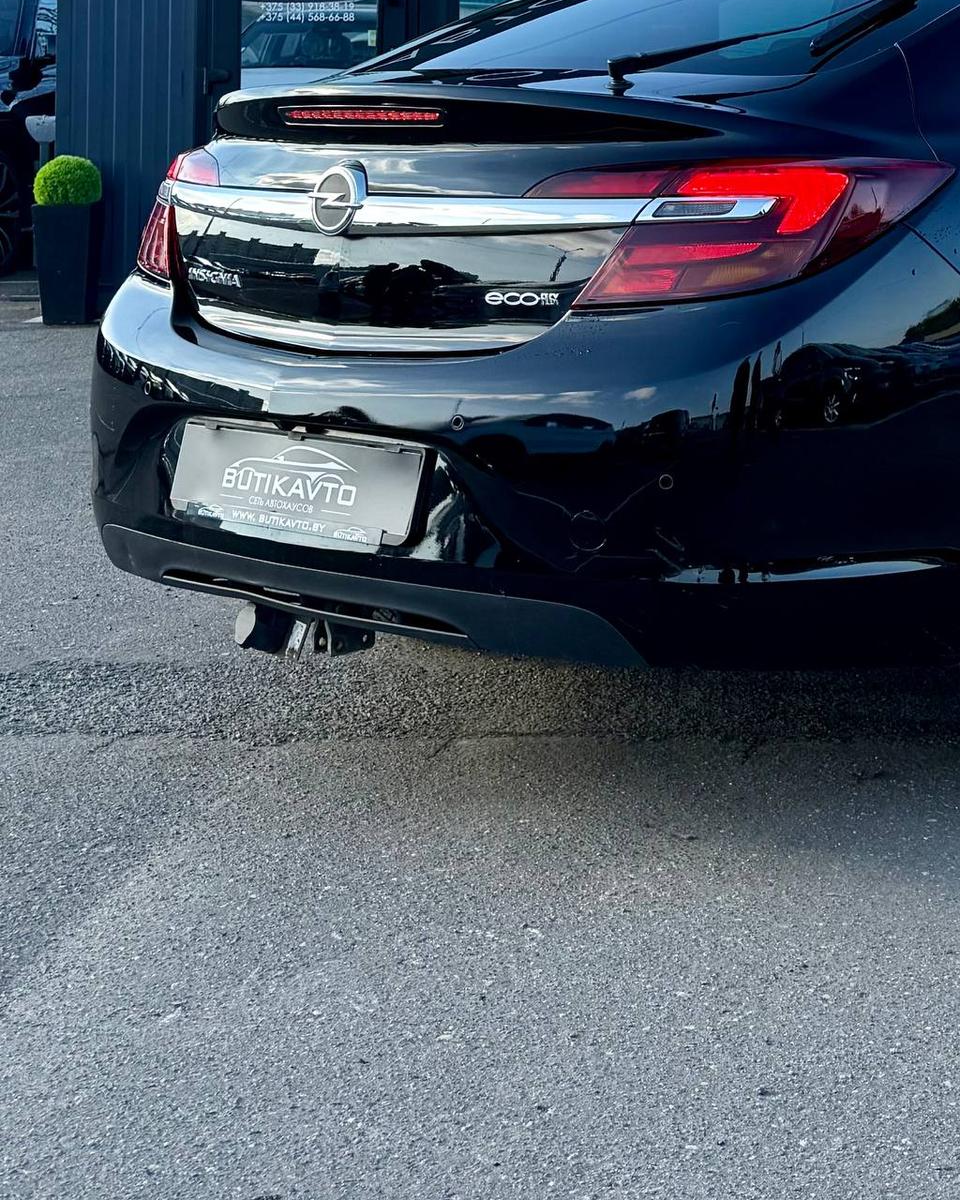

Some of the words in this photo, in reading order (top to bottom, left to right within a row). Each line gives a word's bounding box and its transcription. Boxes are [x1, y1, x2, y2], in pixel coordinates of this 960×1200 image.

[286, 12, 305, 23] (44)
[308, 12, 355, 22] 568-66-88
[187, 267, 242, 288] INSIGNIA
[221, 467, 357, 507] BUTIKAVTO
[248, 495, 264, 506] СЕТЬ
[265, 498, 314, 514] АВТОХАУСОВ
[232, 509, 257, 522] WWW.
[258, 514, 327, 533] BUTIKAVTO.BY
